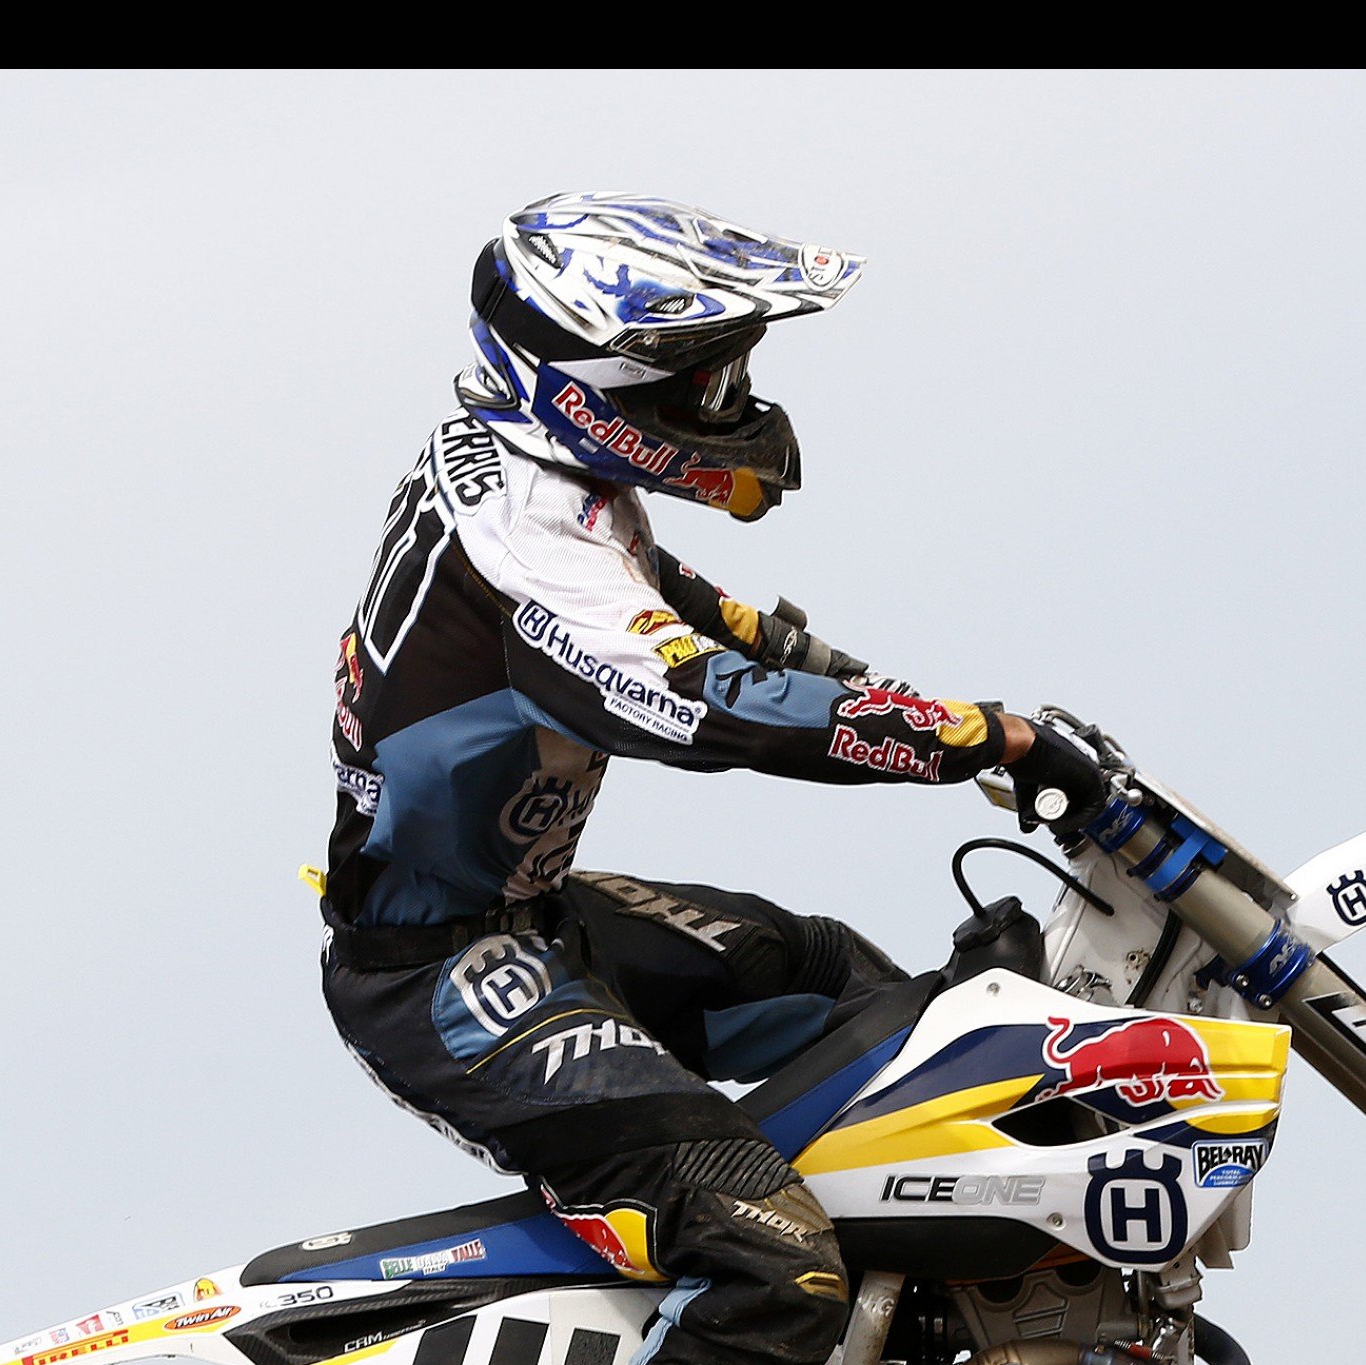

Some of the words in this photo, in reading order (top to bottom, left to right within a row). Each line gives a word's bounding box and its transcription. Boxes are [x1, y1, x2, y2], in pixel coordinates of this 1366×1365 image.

[547, 623, 696, 727] Husqvarna
[731, 1200, 808, 1243] THOR
[278, 1285, 334, 1307] 350
[175, 1313, 211, 1329] Twin
